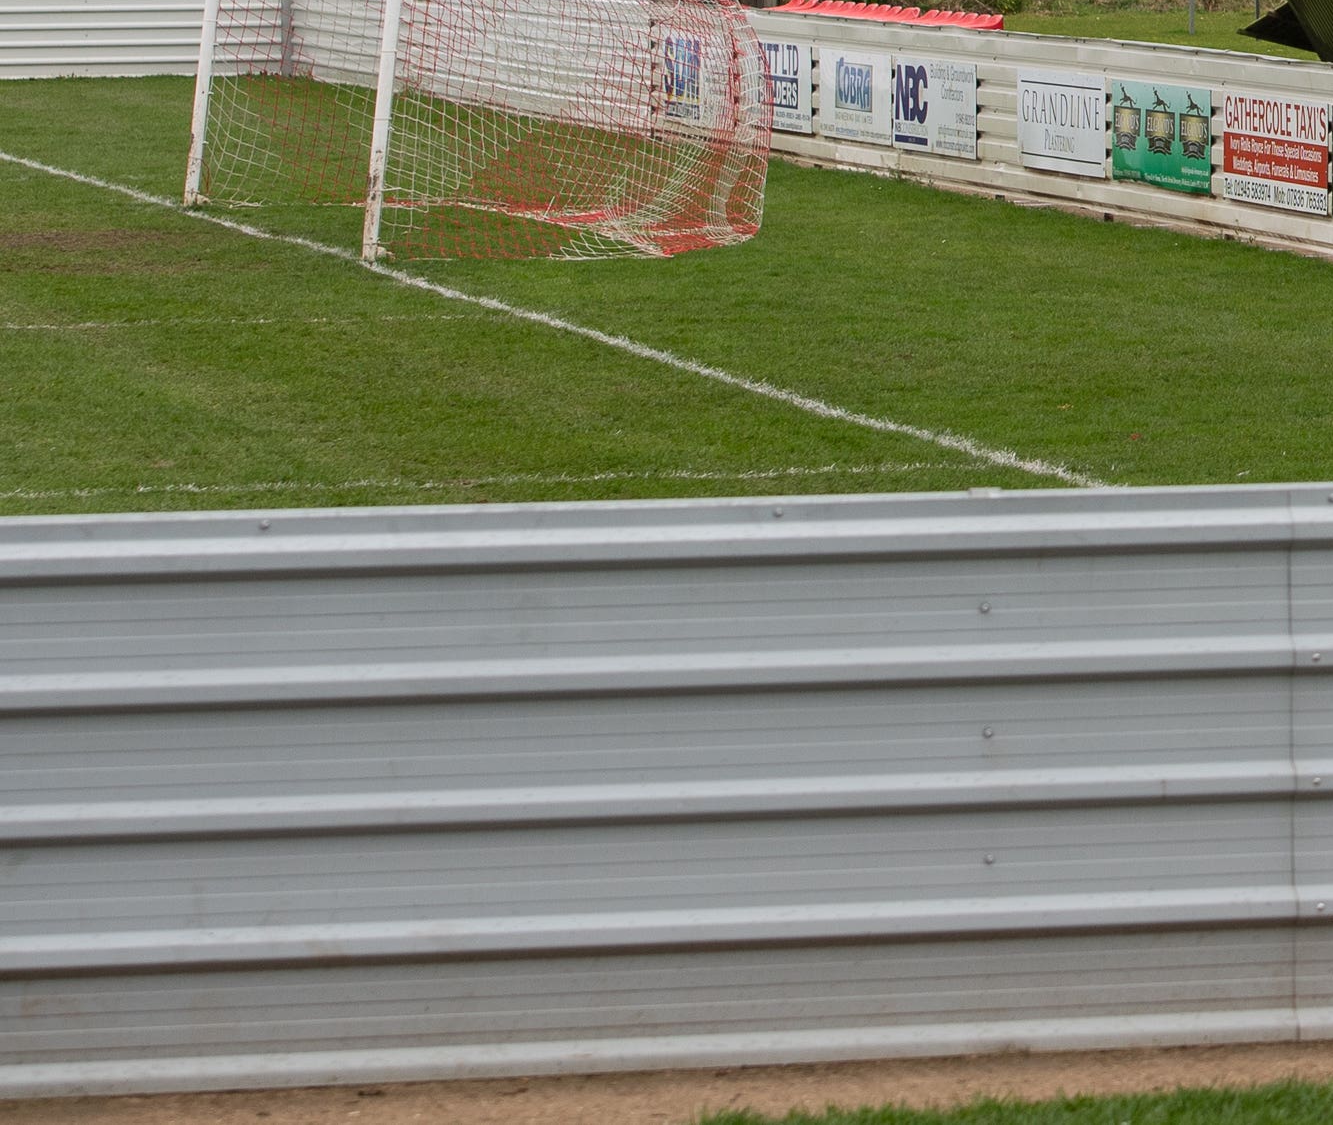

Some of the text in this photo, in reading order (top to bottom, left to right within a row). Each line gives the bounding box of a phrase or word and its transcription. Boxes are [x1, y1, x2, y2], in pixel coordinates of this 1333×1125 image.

[782, 44, 799, 76] LTD
[838, 57, 870, 109] COBRA
[895, 64, 928, 124] NBC
[1022, 89, 1100, 131] GRANDLINE
[1225, 95, 1327, 142] GATHERCOLE TAXI'S
[1290, 164, 1294, 179] &
[1294, 165, 1319, 183] Limousines
[1301, 145, 1322, 163] Occasions
